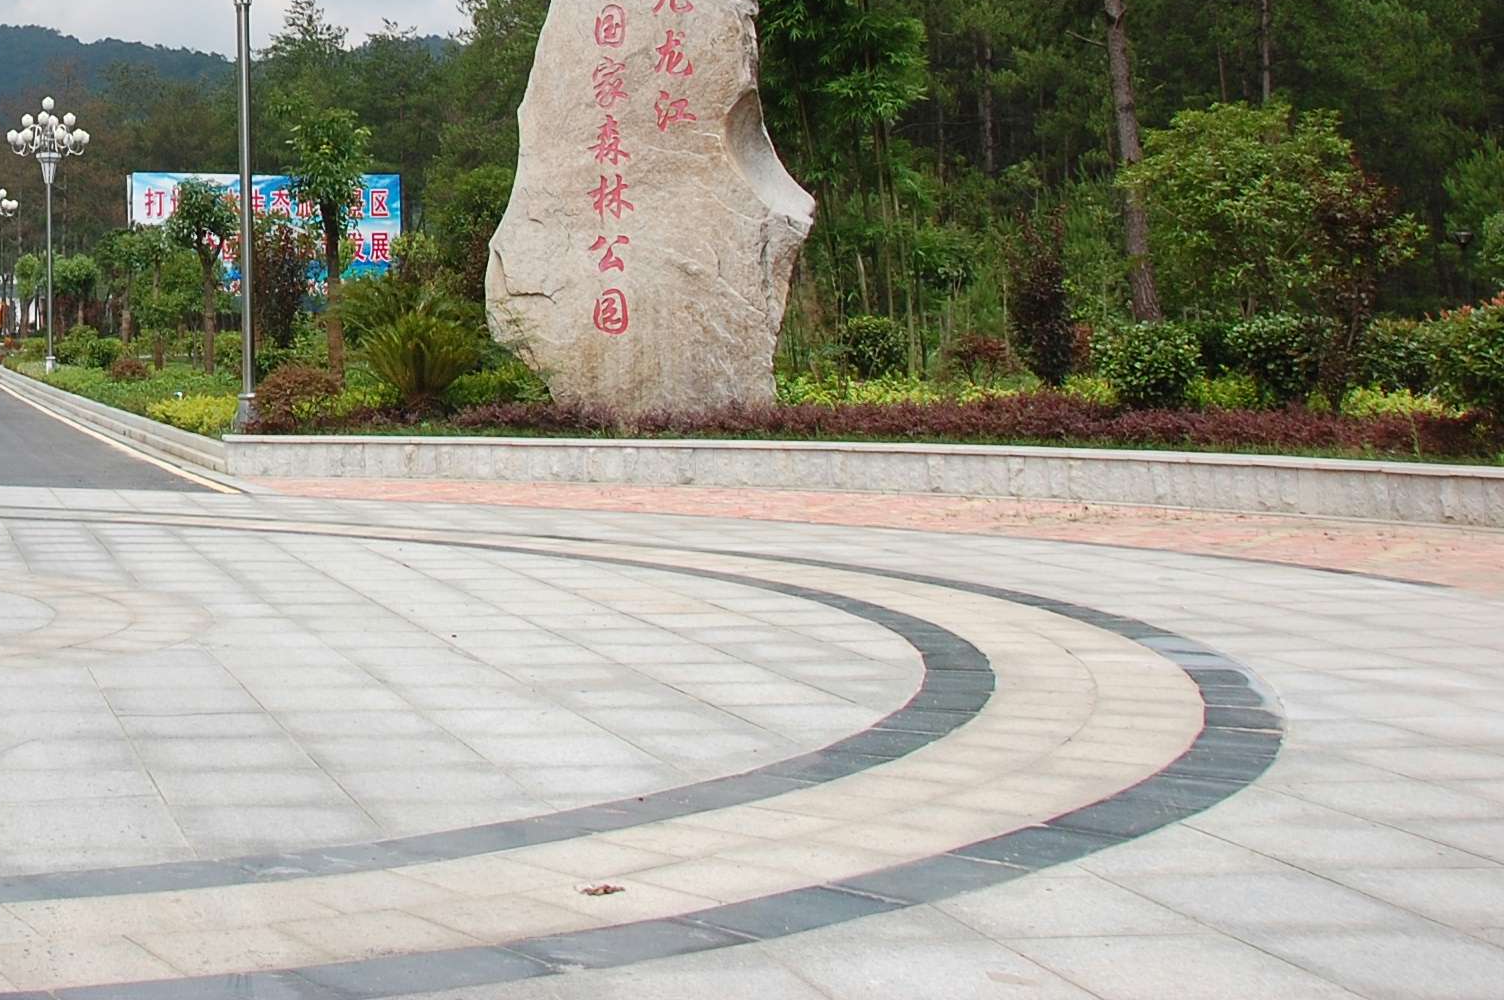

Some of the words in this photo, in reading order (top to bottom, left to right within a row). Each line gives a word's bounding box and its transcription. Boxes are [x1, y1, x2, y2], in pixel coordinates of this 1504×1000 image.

[586, 3, 635, 337] 国家森林公园
